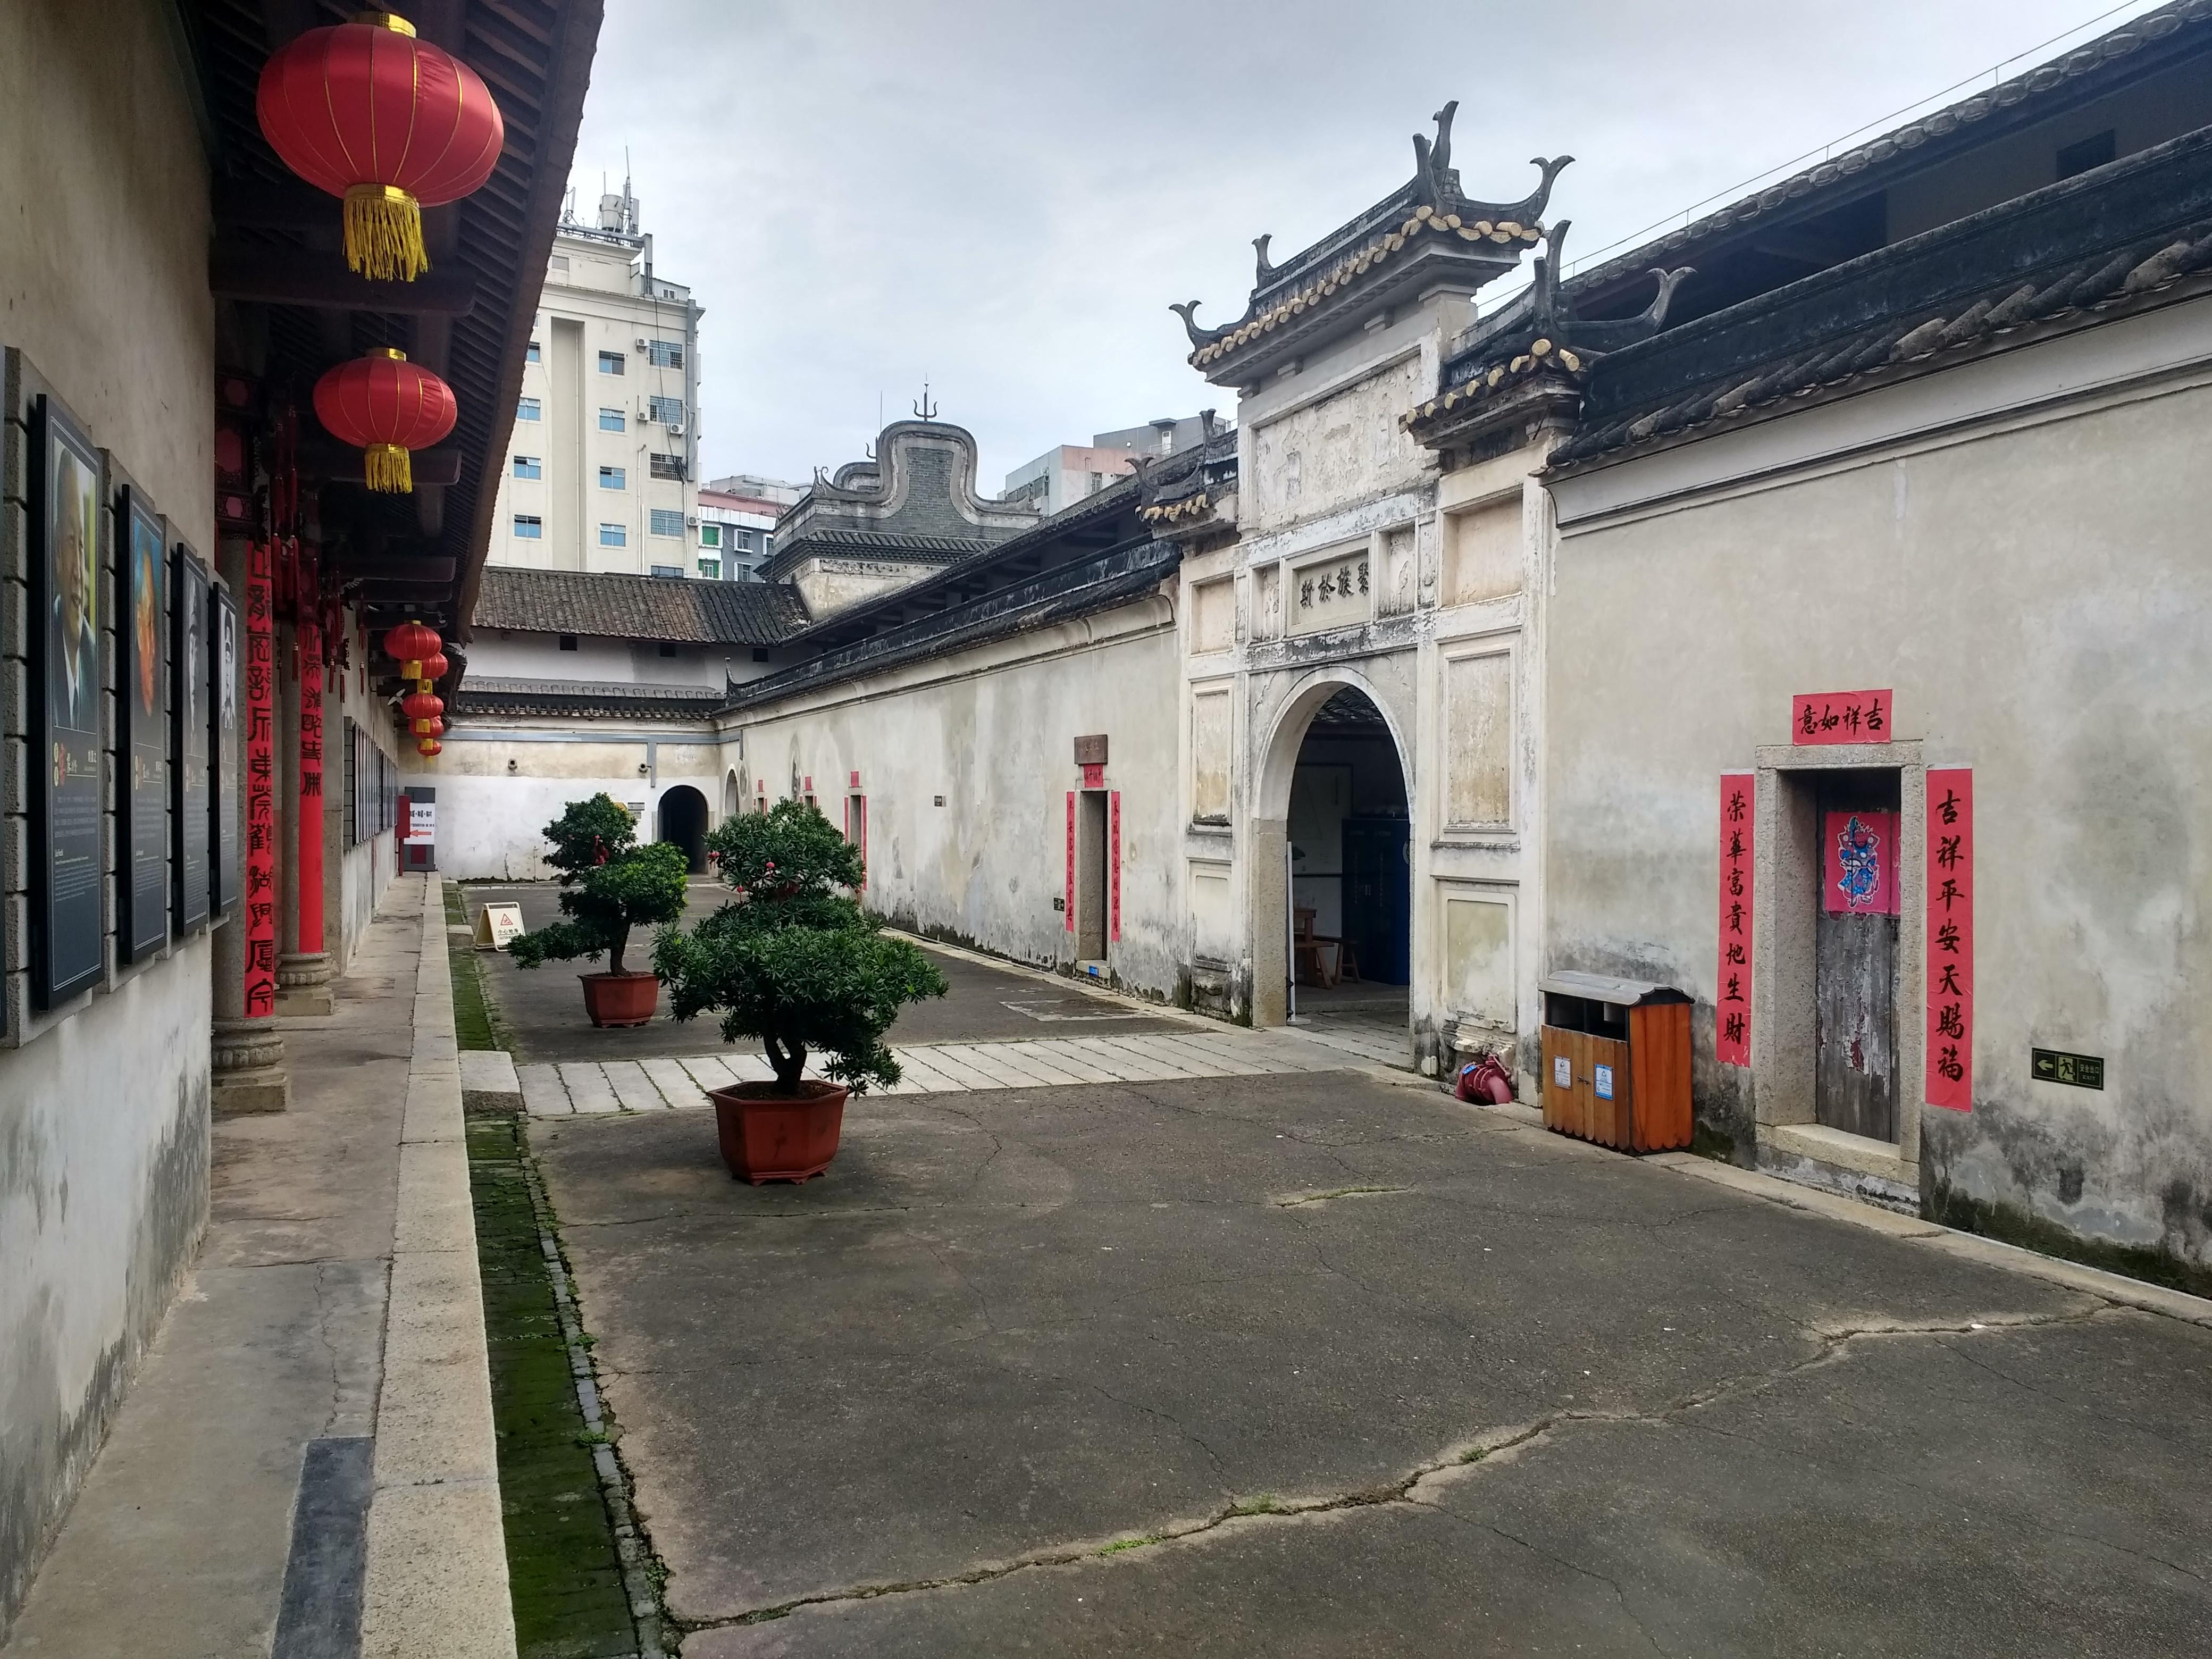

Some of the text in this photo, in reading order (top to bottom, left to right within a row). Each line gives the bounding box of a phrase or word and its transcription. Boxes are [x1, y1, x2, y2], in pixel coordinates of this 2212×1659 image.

[1935, 789, 1964, 1083] 吉祥平安天賜福
[2080, 1064, 2099, 1074] 安全出口
